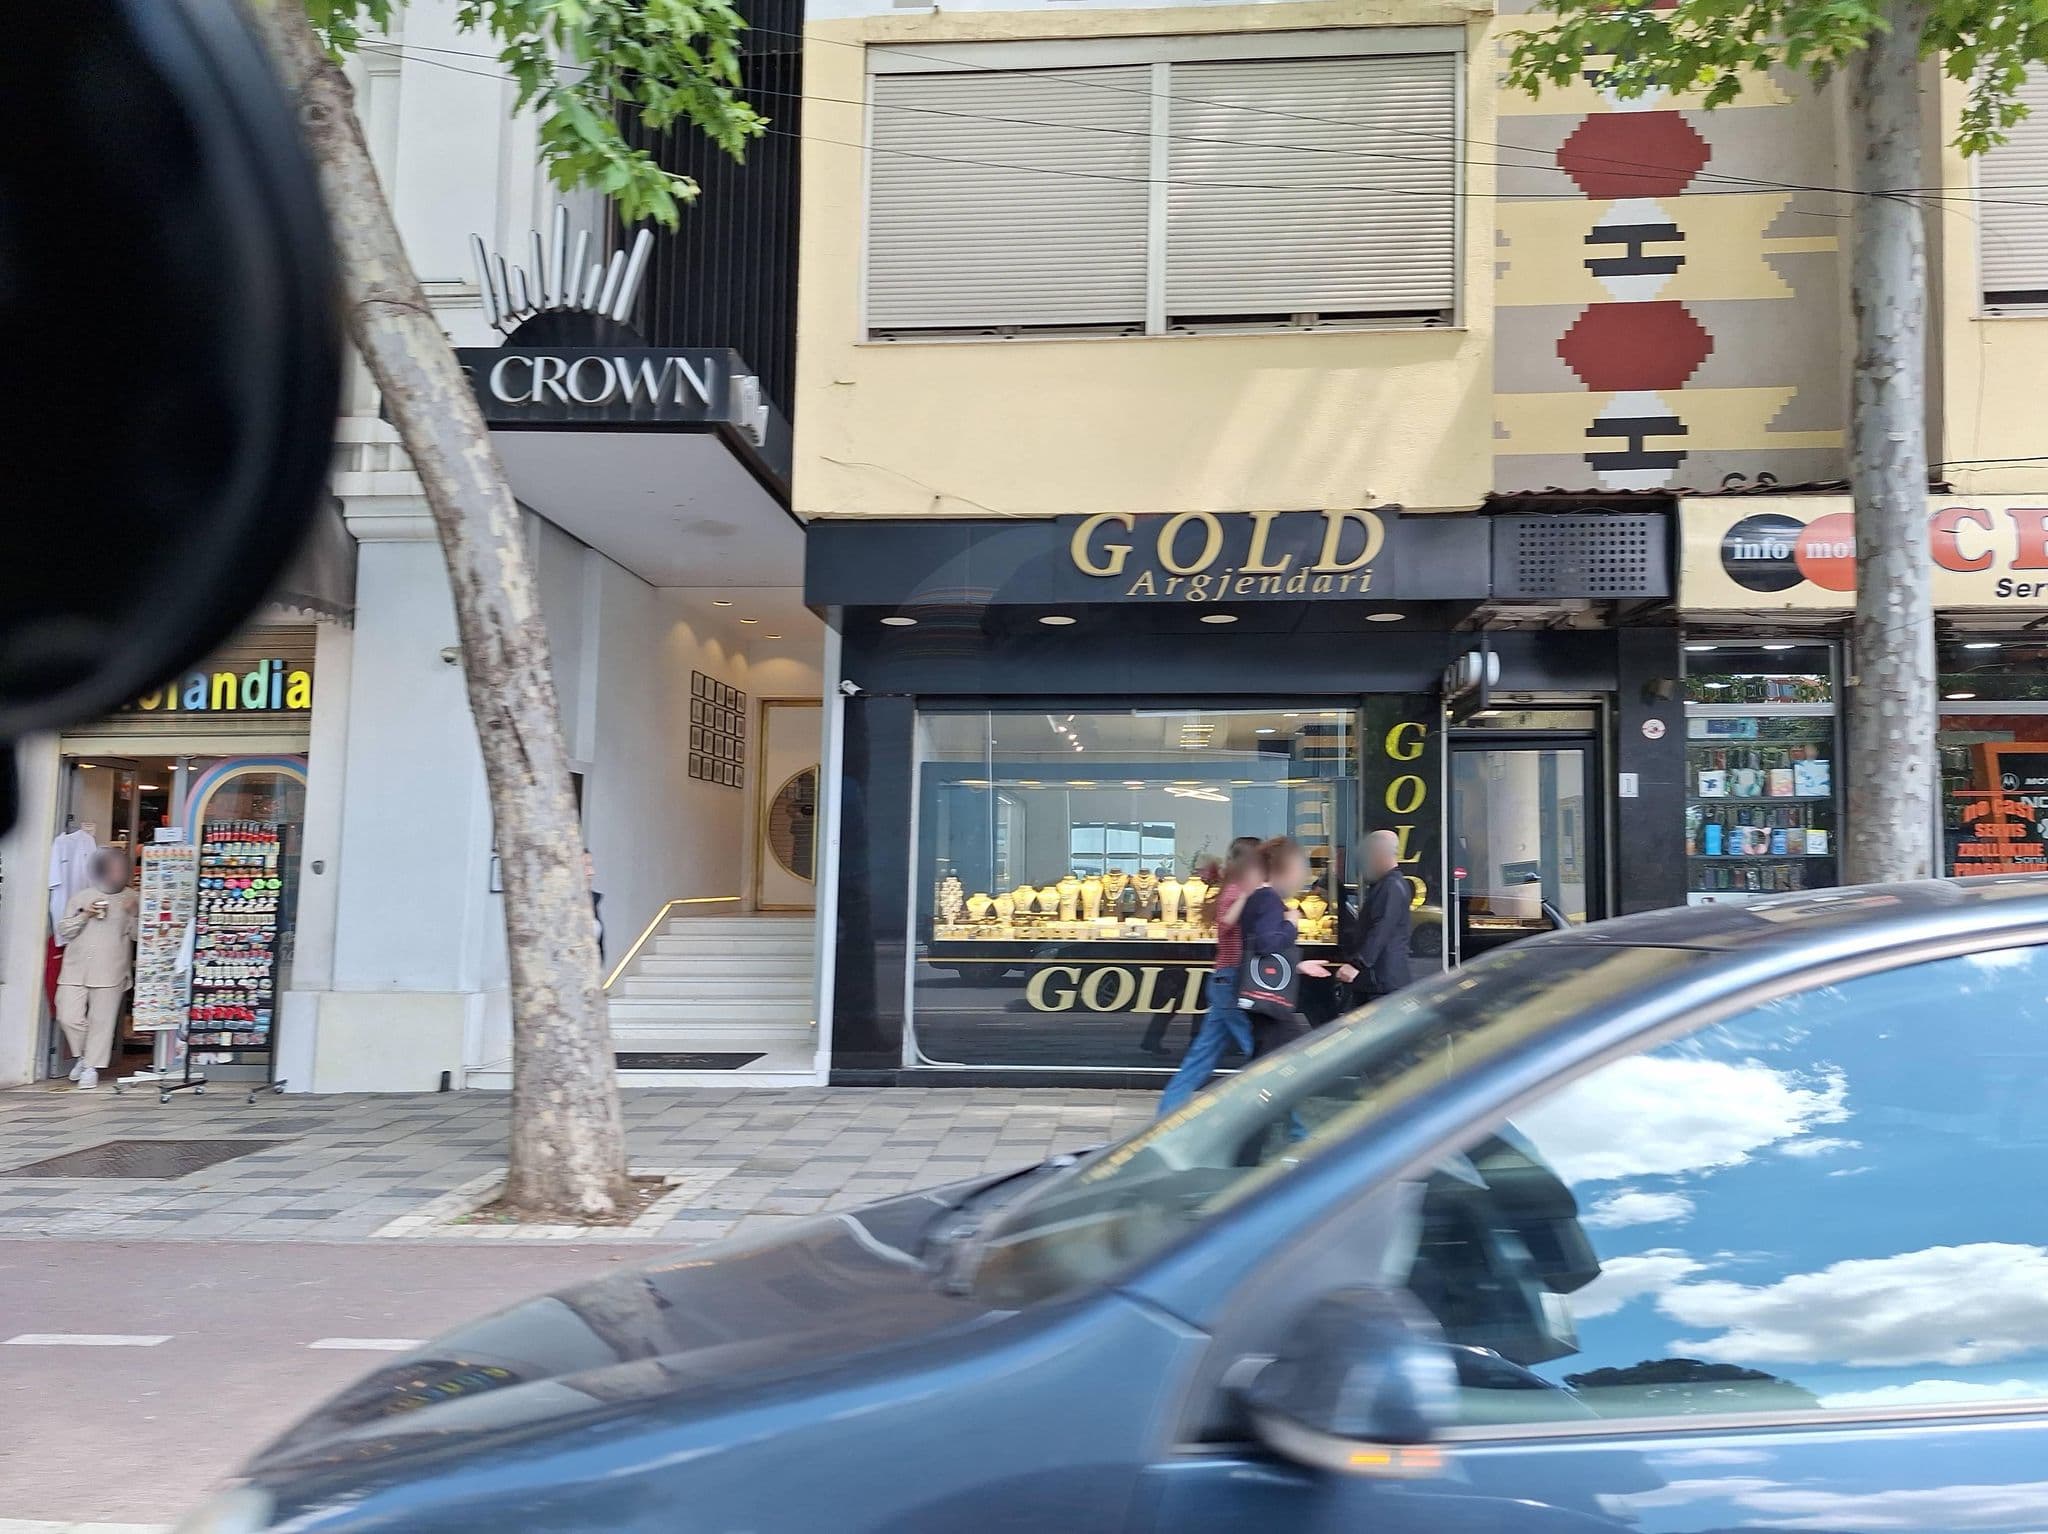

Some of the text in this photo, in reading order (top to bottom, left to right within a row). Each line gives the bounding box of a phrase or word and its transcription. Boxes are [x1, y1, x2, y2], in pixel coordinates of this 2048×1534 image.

[489, 355, 713, 404] CROWN
[1070, 509, 1386, 577] GOLD
[1732, 536, 1790, 560] info
[1125, 566, 1374, 602] Argjendari
[121, 658, 312, 711] landia
